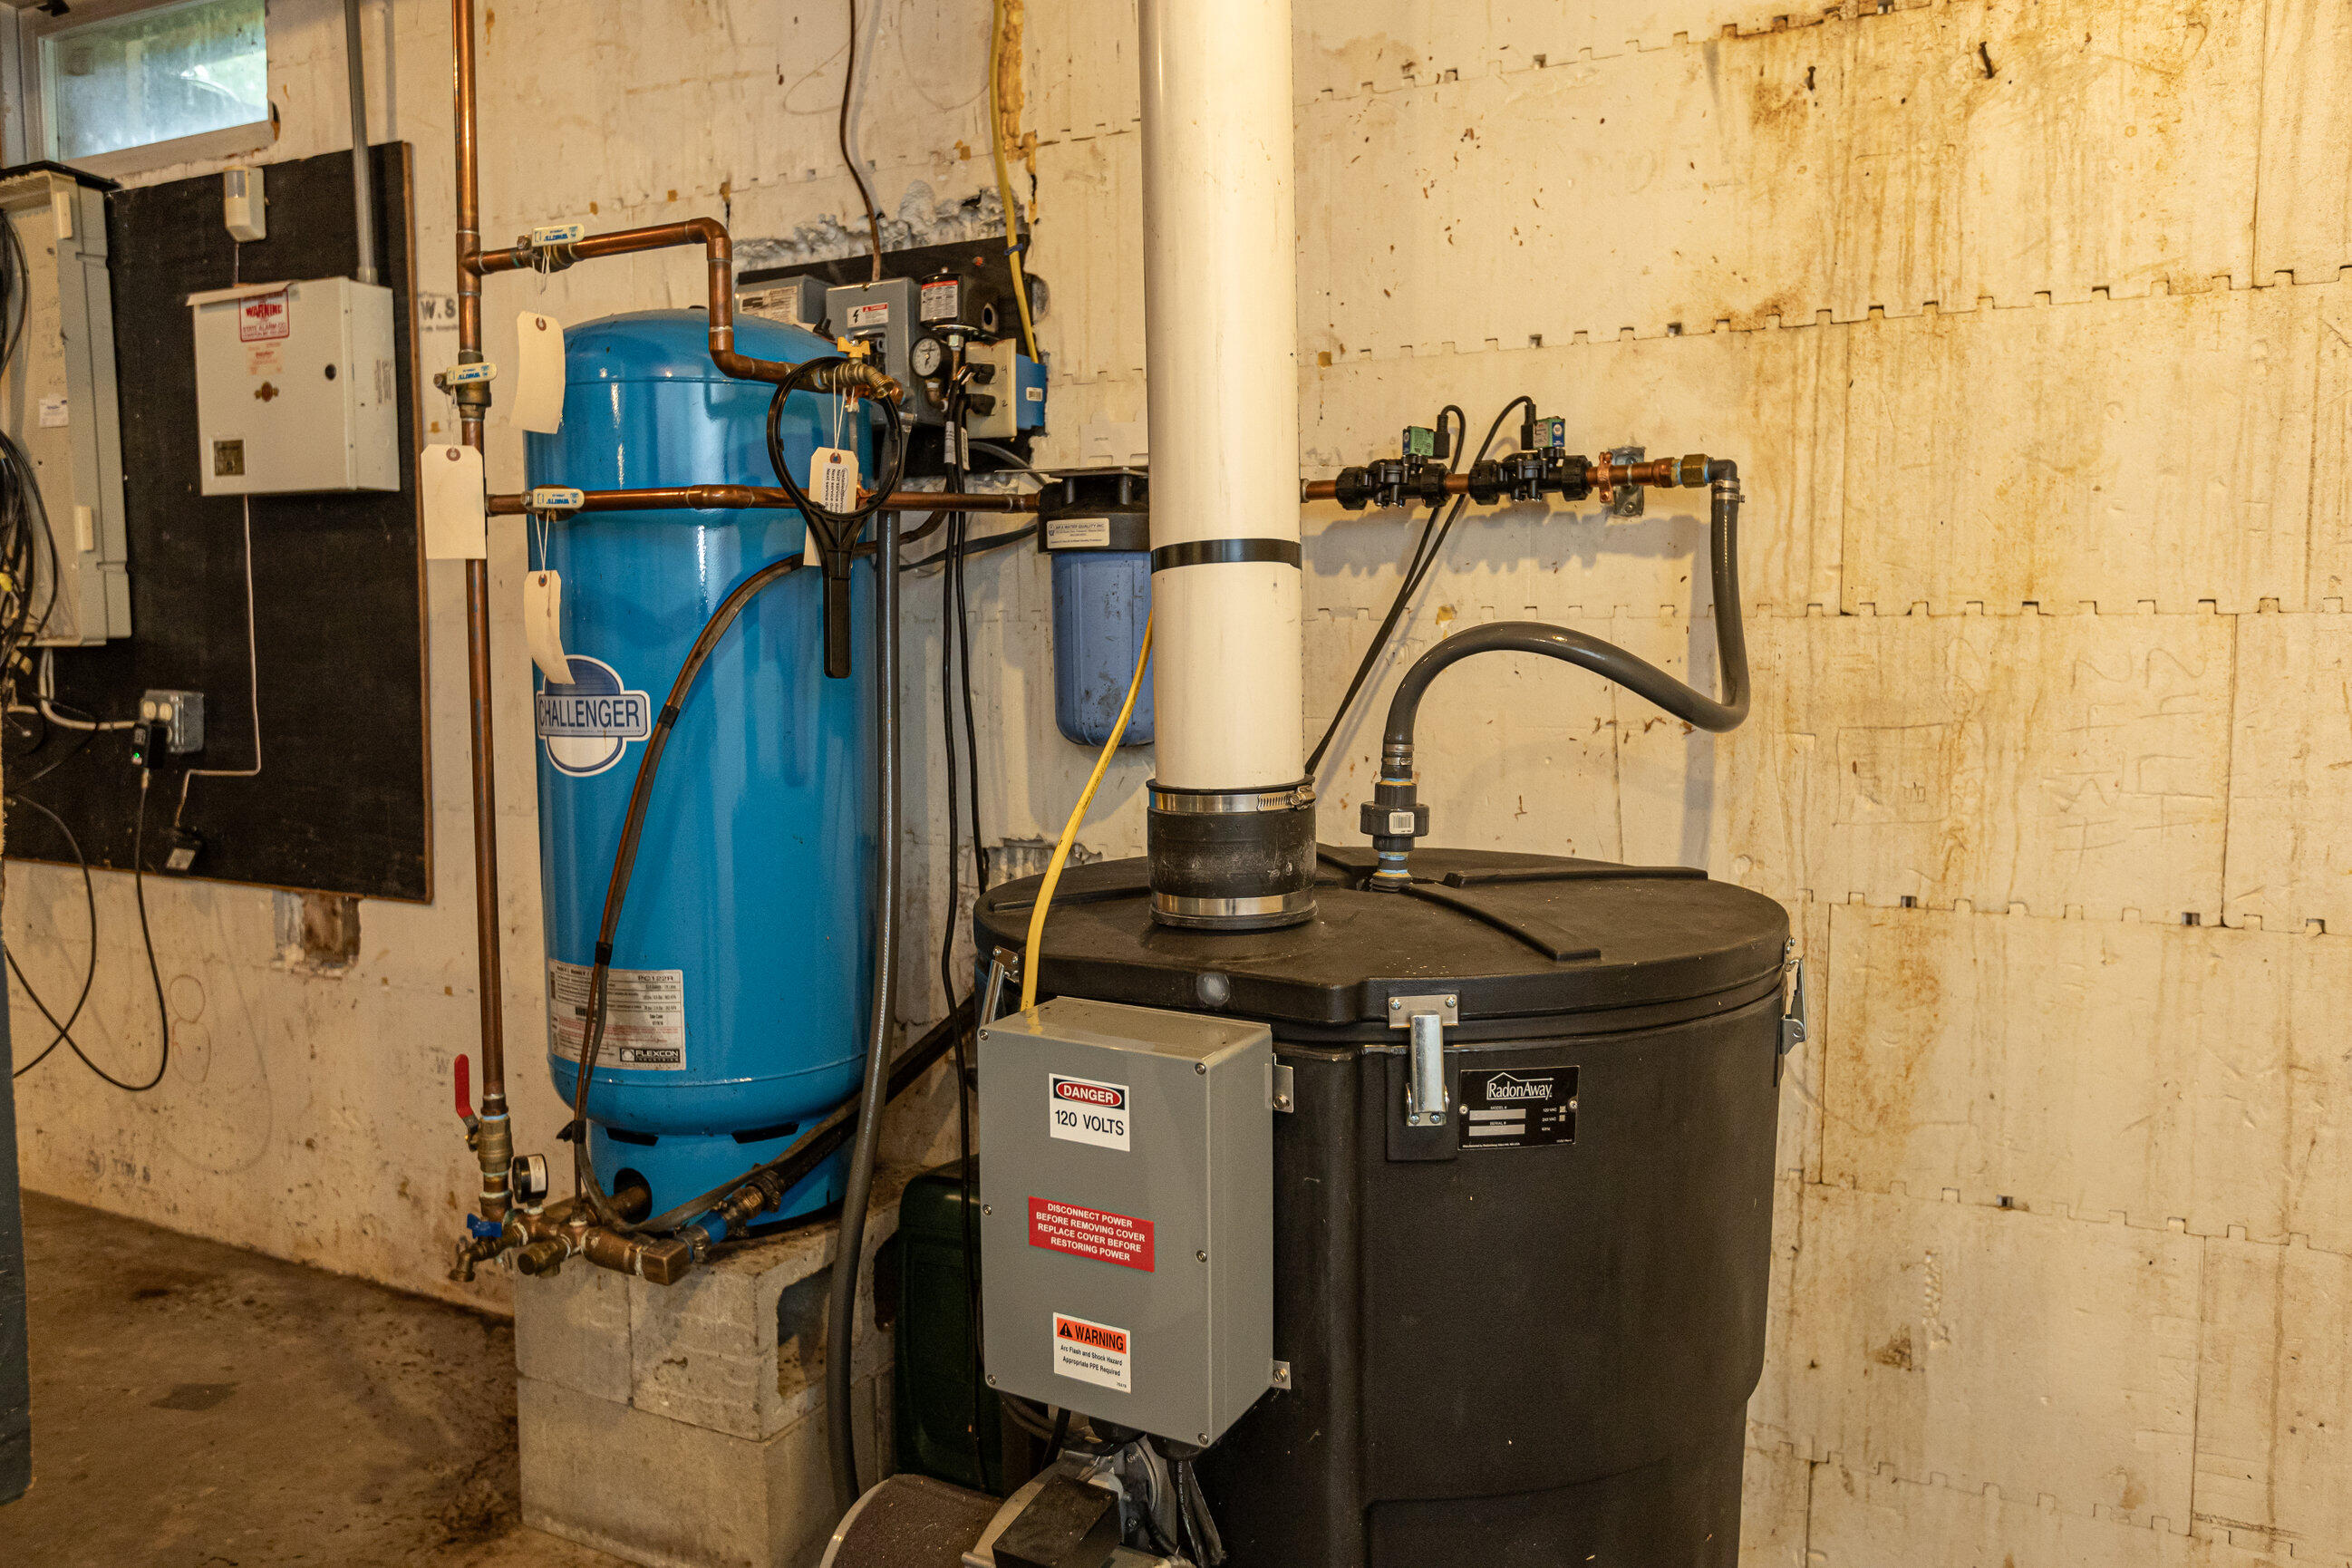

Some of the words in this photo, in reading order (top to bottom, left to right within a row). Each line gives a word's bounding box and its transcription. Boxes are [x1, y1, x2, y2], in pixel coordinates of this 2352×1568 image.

[246, 304, 283, 318] WARNING
[539, 699, 640, 728] CHALLENGER
[1063, 1084, 1114, 1104] DANGER
[1489, 1081, 1553, 1100] RadonAway
[1055, 1109, 1077, 1127] 120
[1083, 1114, 1124, 1136] VOLTS
[1036, 1212, 1069, 1225] BEFORE
[1070, 1219, 1114, 1235] REMOVING
[1116, 1229, 1146, 1242] COVER
[1048, 1203, 1099, 1221] DISCONNECT
[1101, 1215, 1133, 1228] POWER
[1038, 1223, 1075, 1238] REPLACE
[1077, 1232, 1106, 1244] COVER
[1108, 1238, 1142, 1253] BEFORE
[1050, 1236, 1098, 1254] RESTORING
[1099, 1247, 1130, 1261] POWER
[1075, 1324, 1124, 1350] WARNING
[1062, 1356, 1089, 1368] Appropriate
[1089, 1362, 1099, 1370] PPE
[1099, 1365, 1121, 1377] Required
[1070, 1347, 1081, 1356] Flash
[1091, 1352, 1106, 1360] Shock
[1107, 1357, 1123, 1366] Hazard
